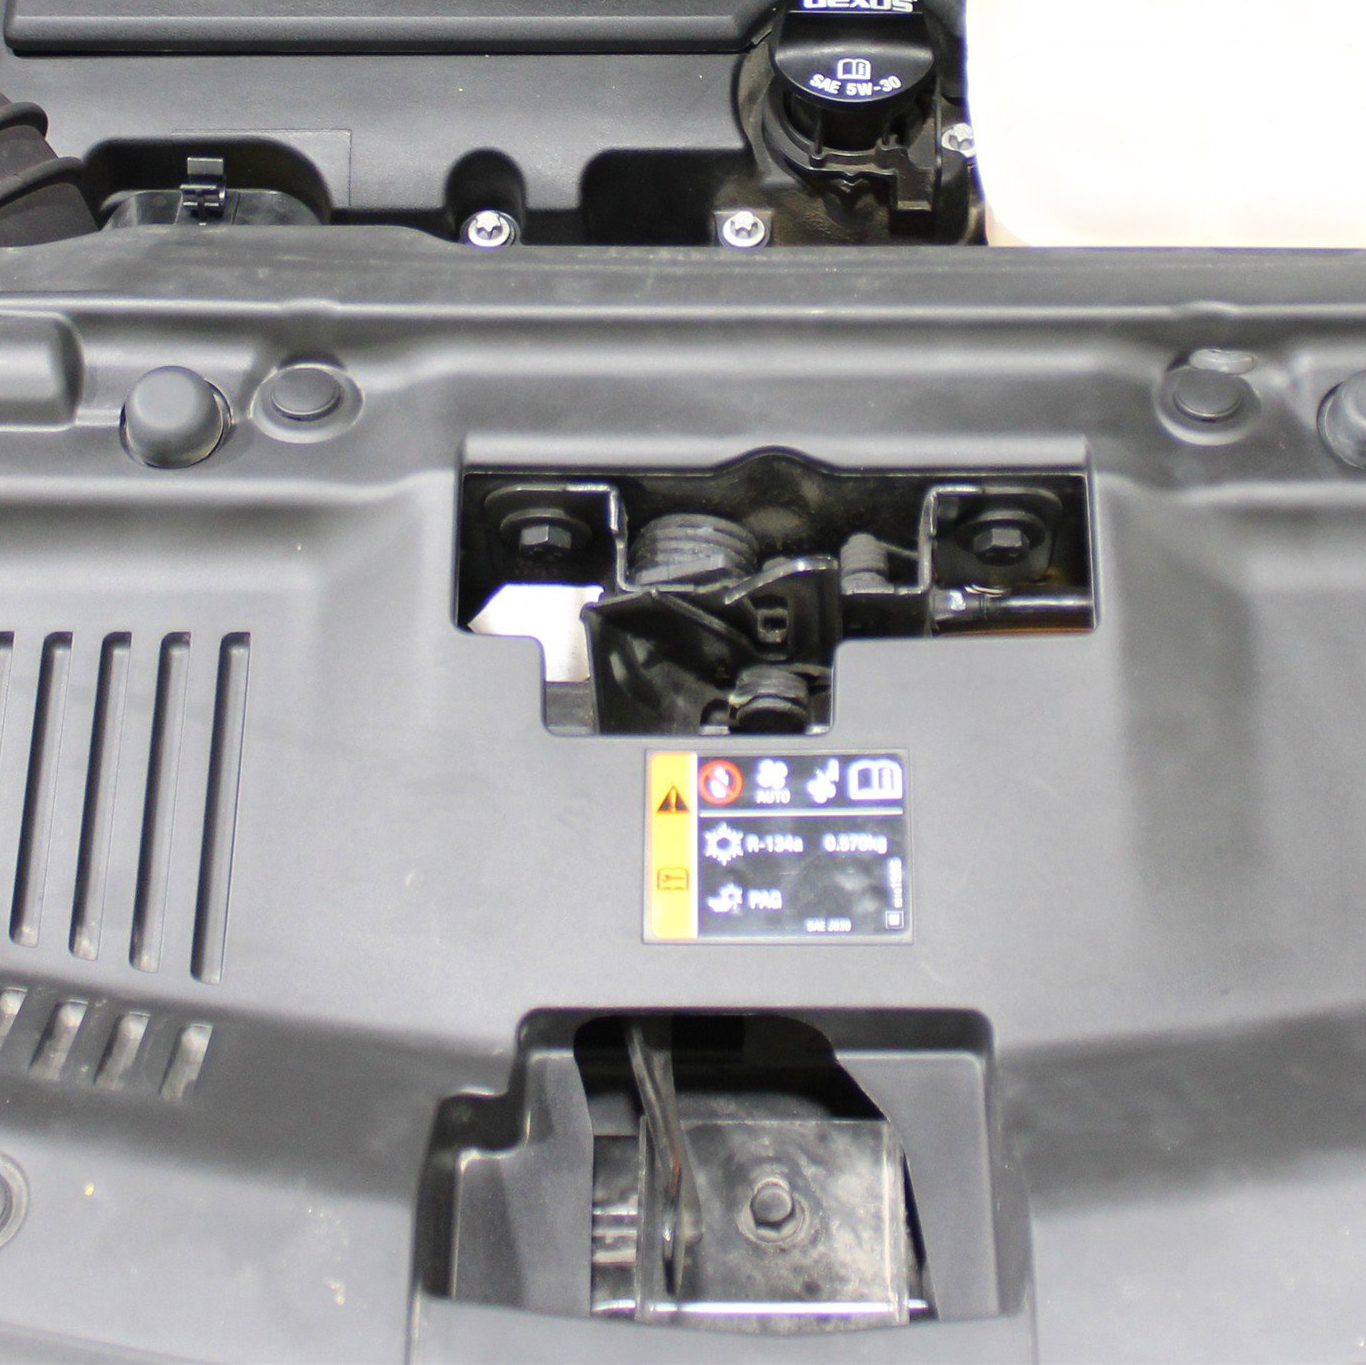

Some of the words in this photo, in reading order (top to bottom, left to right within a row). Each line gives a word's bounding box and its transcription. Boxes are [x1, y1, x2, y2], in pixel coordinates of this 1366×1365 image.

[809, 74, 841, 94] SAE
[845, 75, 902, 96] 5W-30
[756, 788, 791, 804] AUTO
[746, 834, 805, 853] R-134a
[748, 889, 783, 910] PAG
